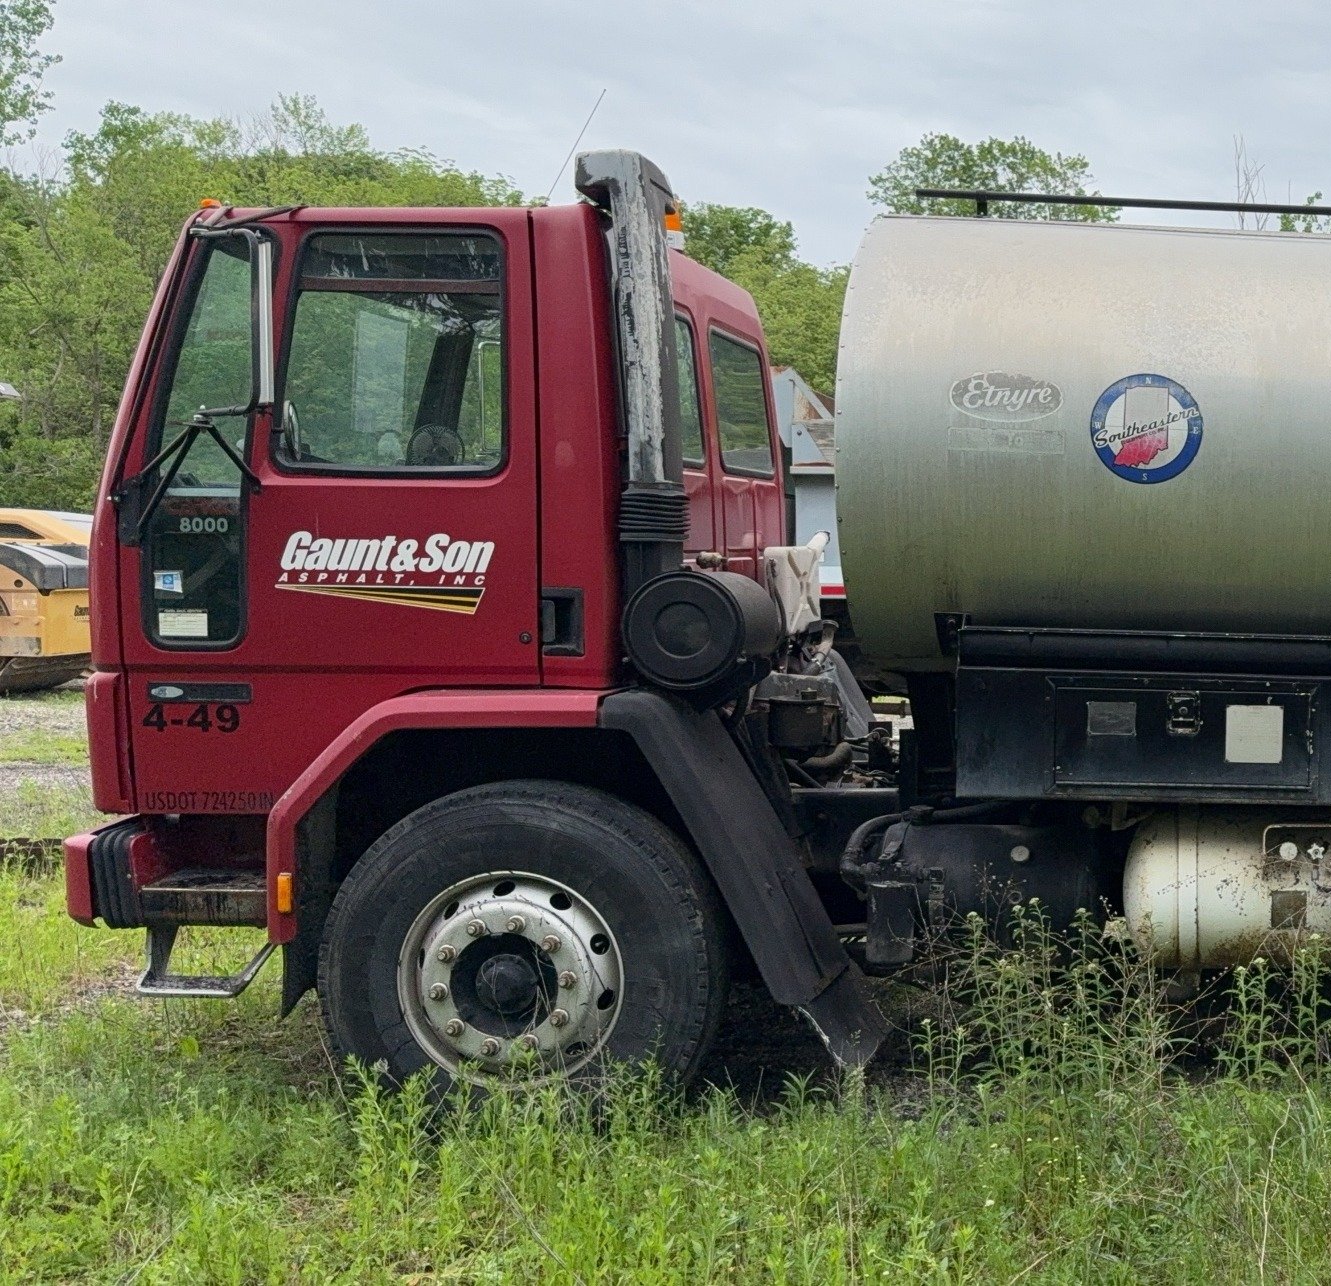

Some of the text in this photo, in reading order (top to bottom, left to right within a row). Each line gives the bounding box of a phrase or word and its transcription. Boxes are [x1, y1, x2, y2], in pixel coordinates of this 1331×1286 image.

[1145, 377, 1152, 385] N
[963, 378, 1053, 412] Etnyre
[1095, 407, 1199, 447] Southeastern
[1142, 473, 1148, 481] S
[180, 517, 228, 533] 8000
[280, 530, 495, 573] Gaunt&Son
[278, 572, 486, 585] ASPHALT, INC
[142, 702, 240, 733] 4-49
[145, 791, 196, 810] USDOT
